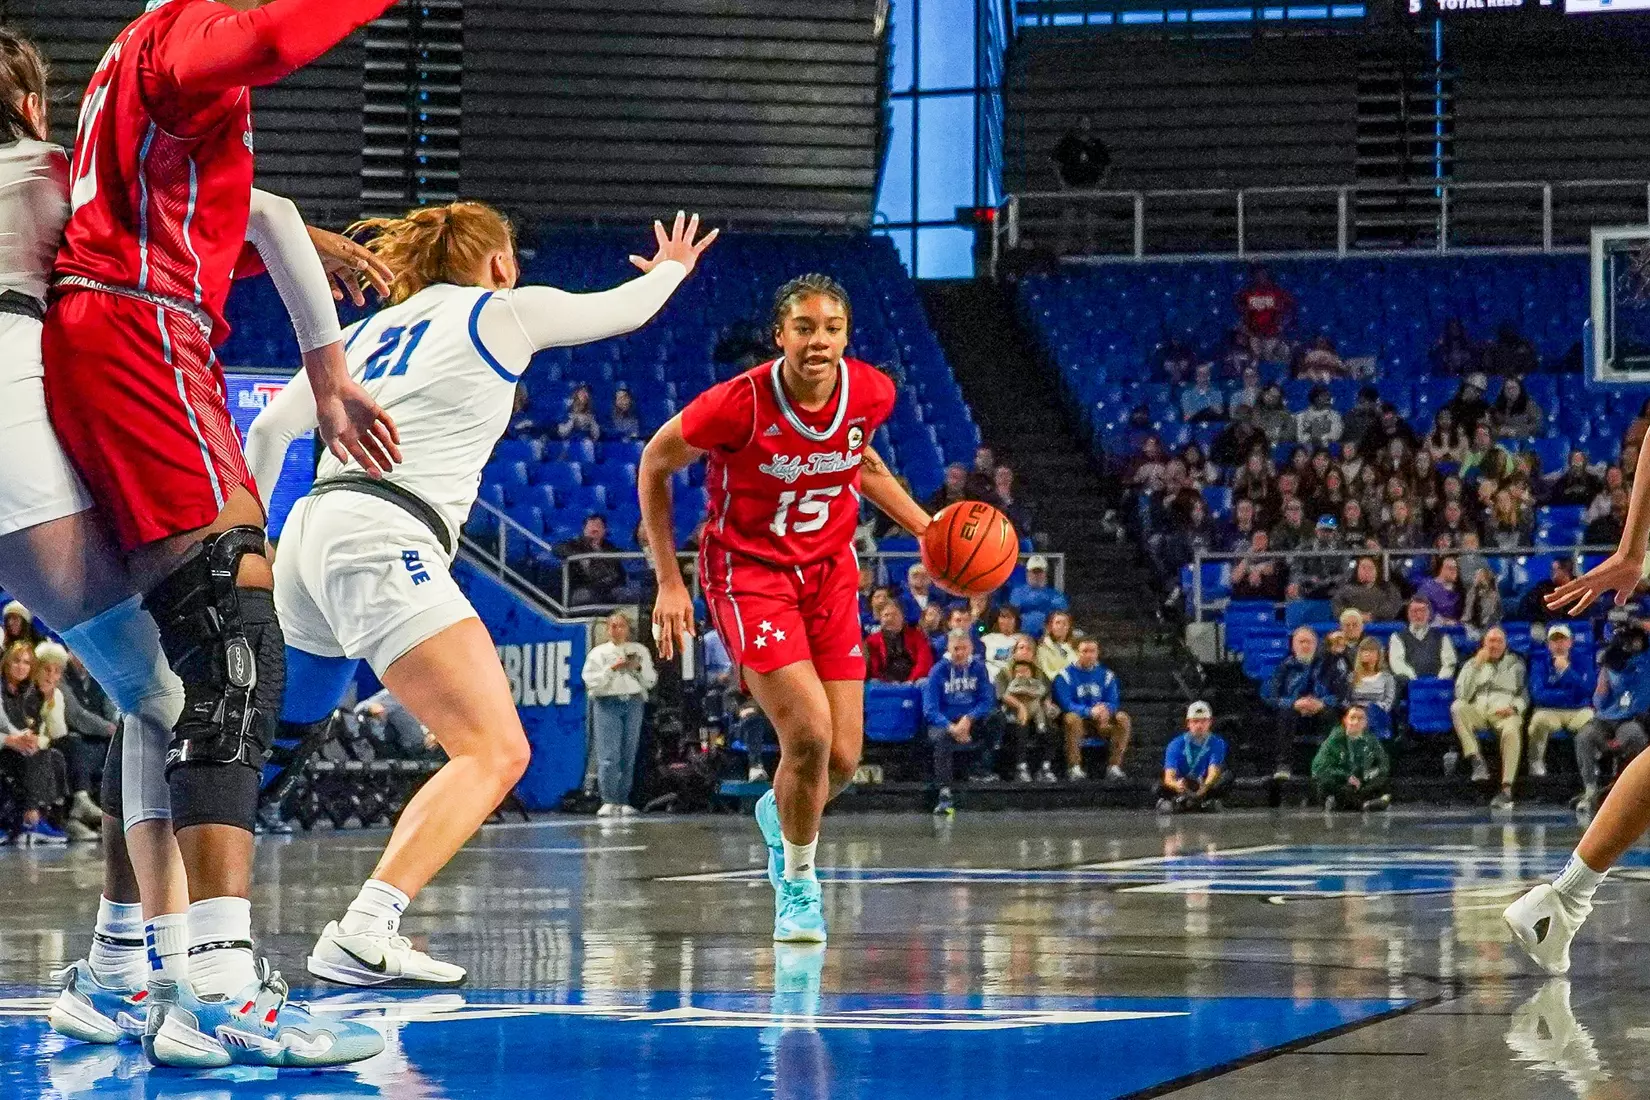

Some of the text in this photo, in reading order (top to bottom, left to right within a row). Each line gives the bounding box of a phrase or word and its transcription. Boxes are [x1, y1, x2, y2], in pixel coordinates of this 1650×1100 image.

[1438, 0, 1484, 10] TOTAL
[361, 319, 432, 383] 21
[759, 453, 804, 483] Lady
[769, 485, 843, 537] 15
[402, 550, 431, 586] BUE
[505, 641, 572, 706] BLUE
